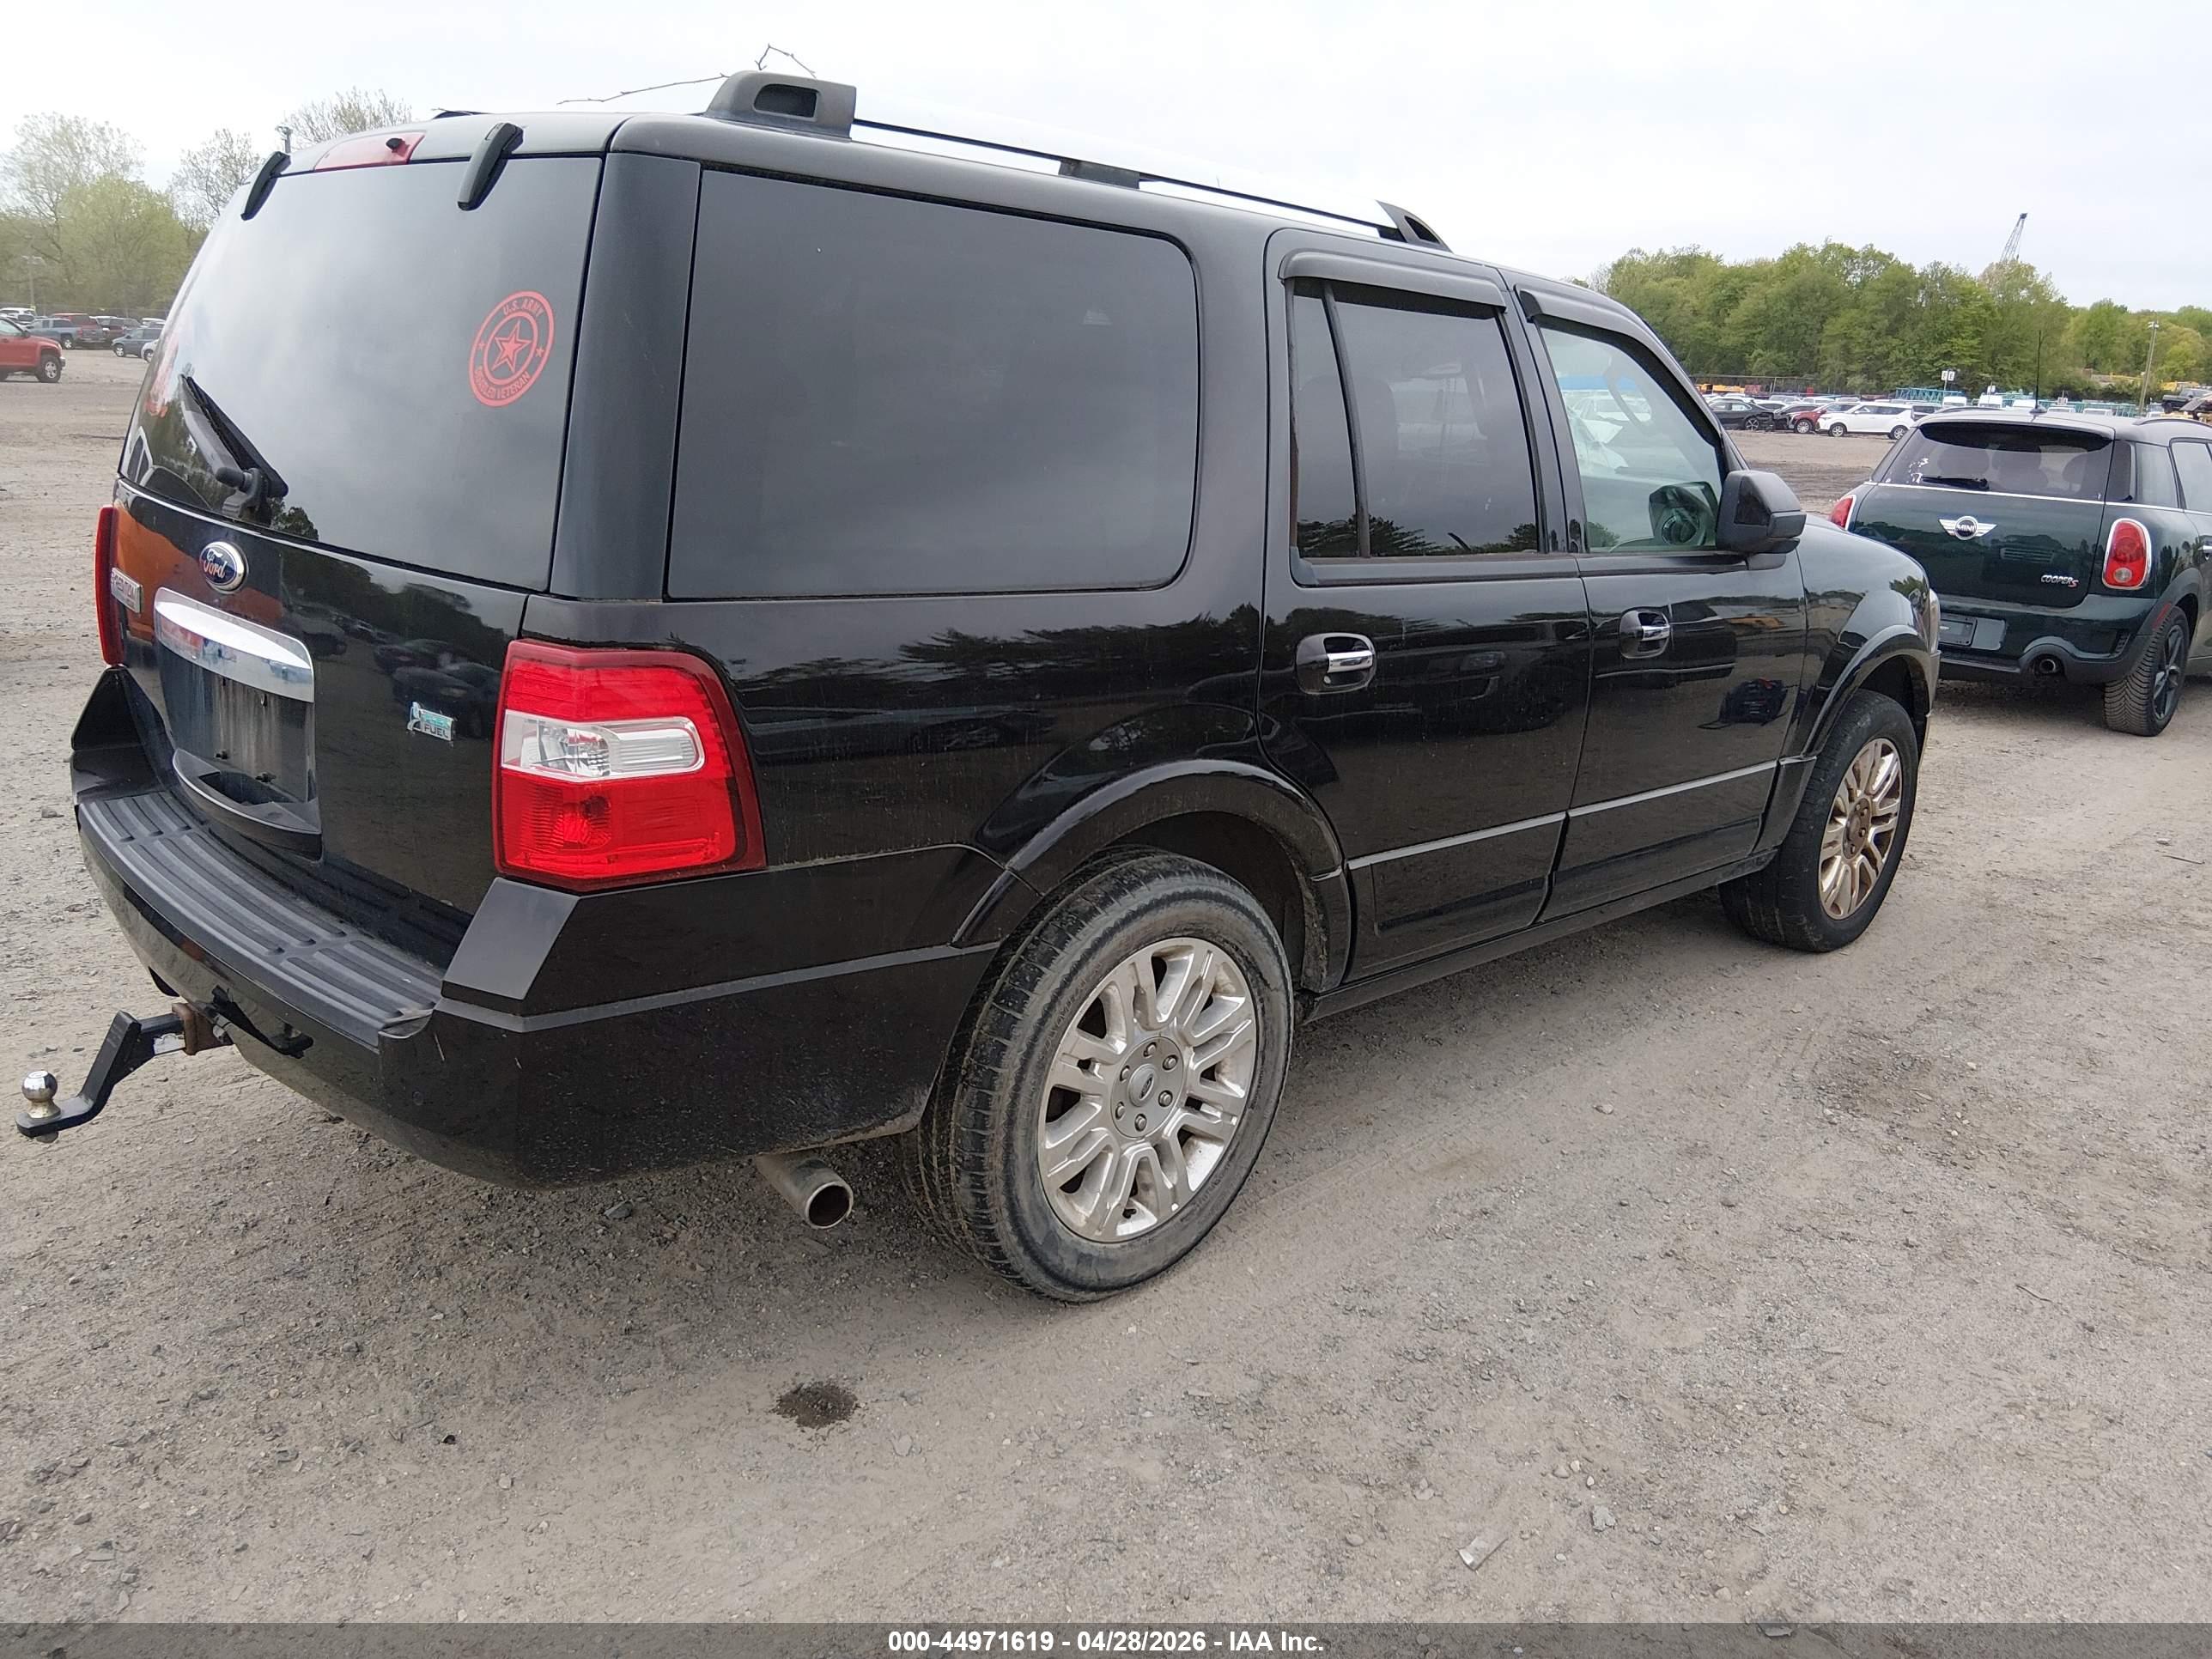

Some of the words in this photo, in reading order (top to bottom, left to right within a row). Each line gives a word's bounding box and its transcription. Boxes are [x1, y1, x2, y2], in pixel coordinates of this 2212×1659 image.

[521, 298, 544, 318] ARMY
[1958, 524, 1976, 532] MINI
[203, 548, 228, 579] Ford
[2040, 574, 2074, 585] COOPER
[424, 723, 448, 738] FUEL
